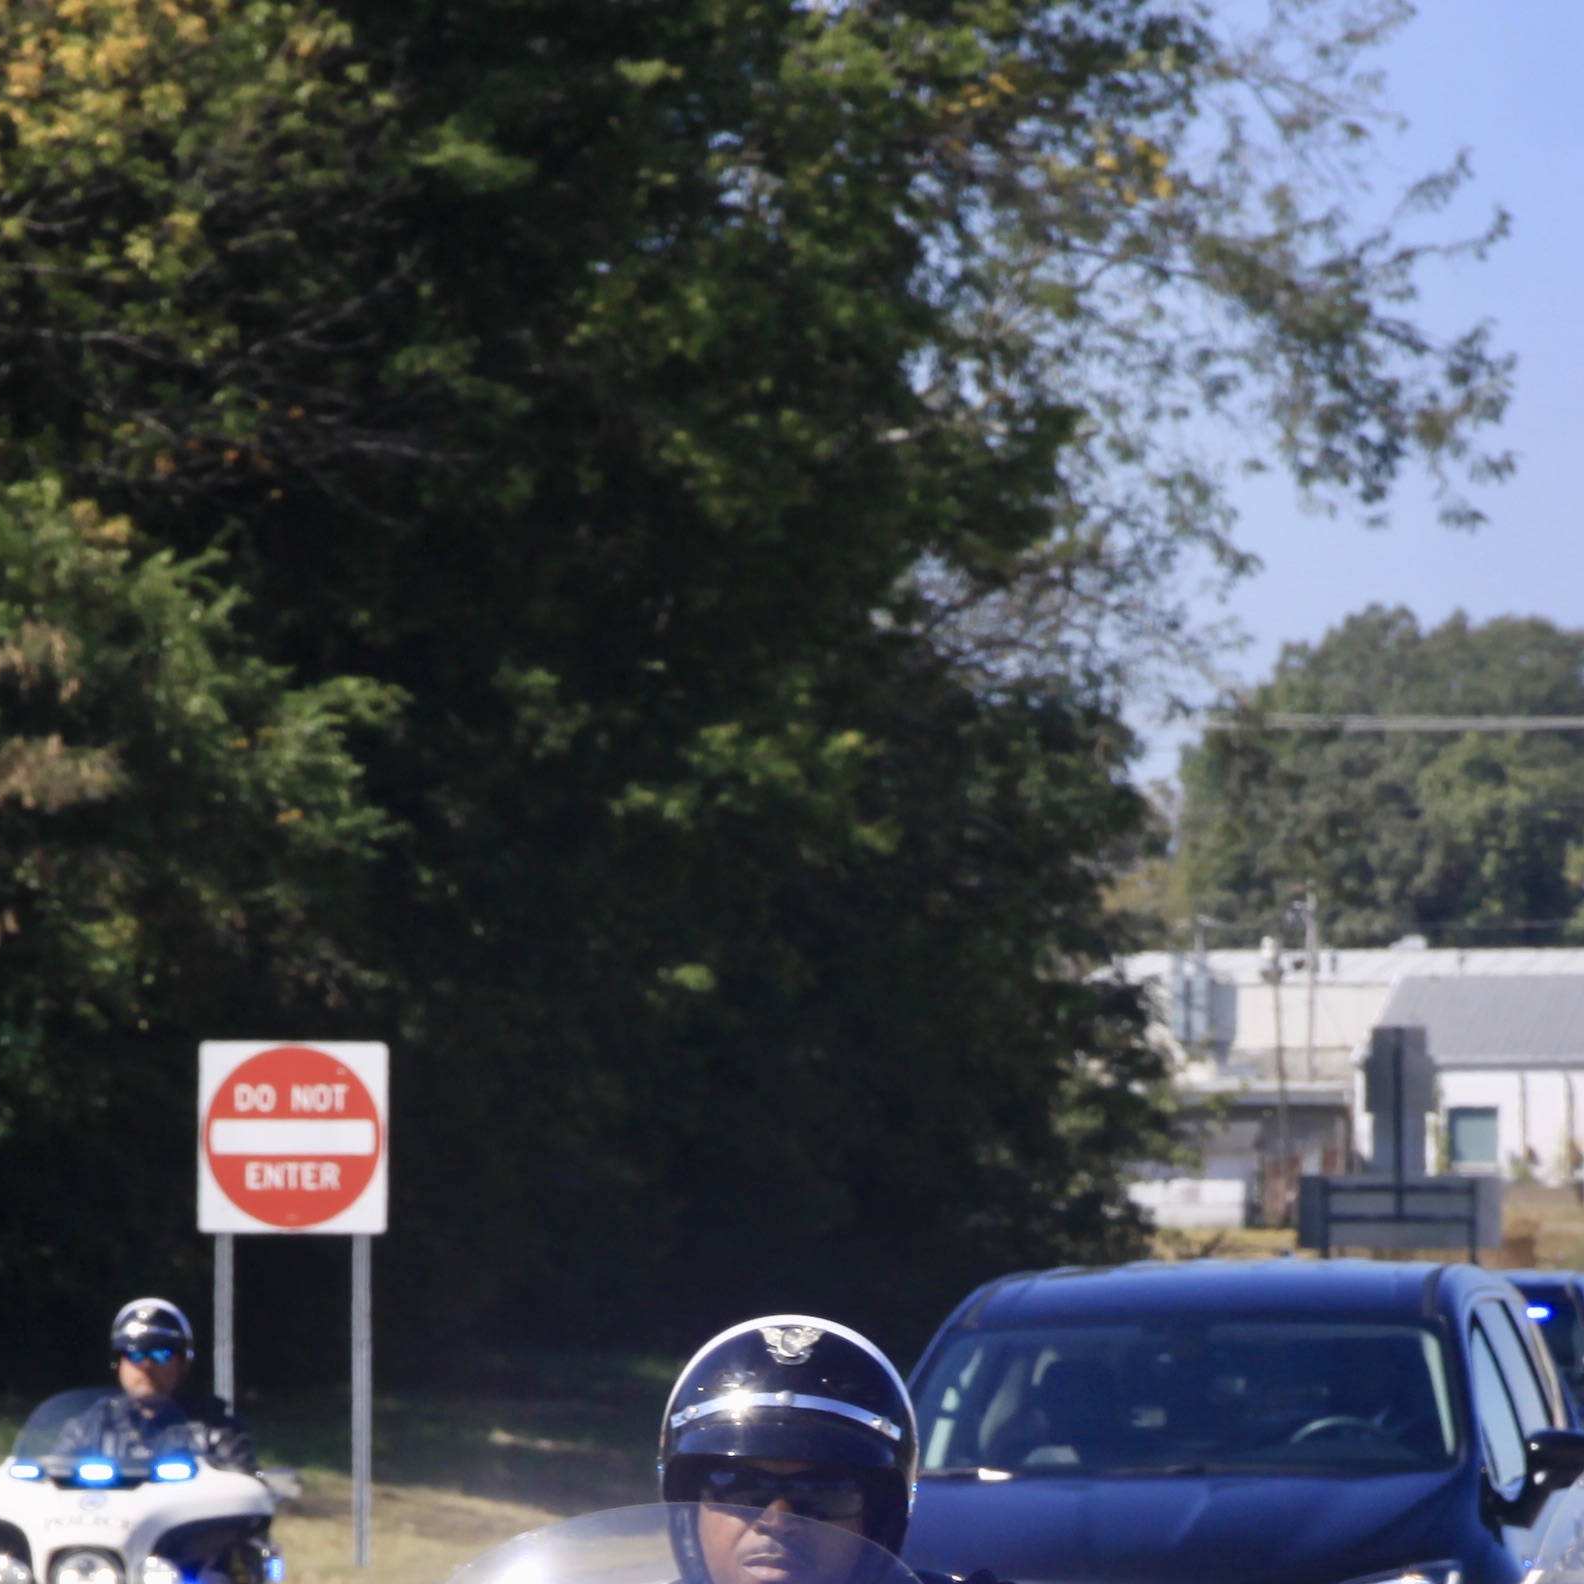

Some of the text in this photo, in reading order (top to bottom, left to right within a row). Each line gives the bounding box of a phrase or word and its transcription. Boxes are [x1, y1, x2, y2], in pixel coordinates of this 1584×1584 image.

[233, 1083, 348, 1113] DO NOT
[244, 1161, 341, 1191] ENTER
